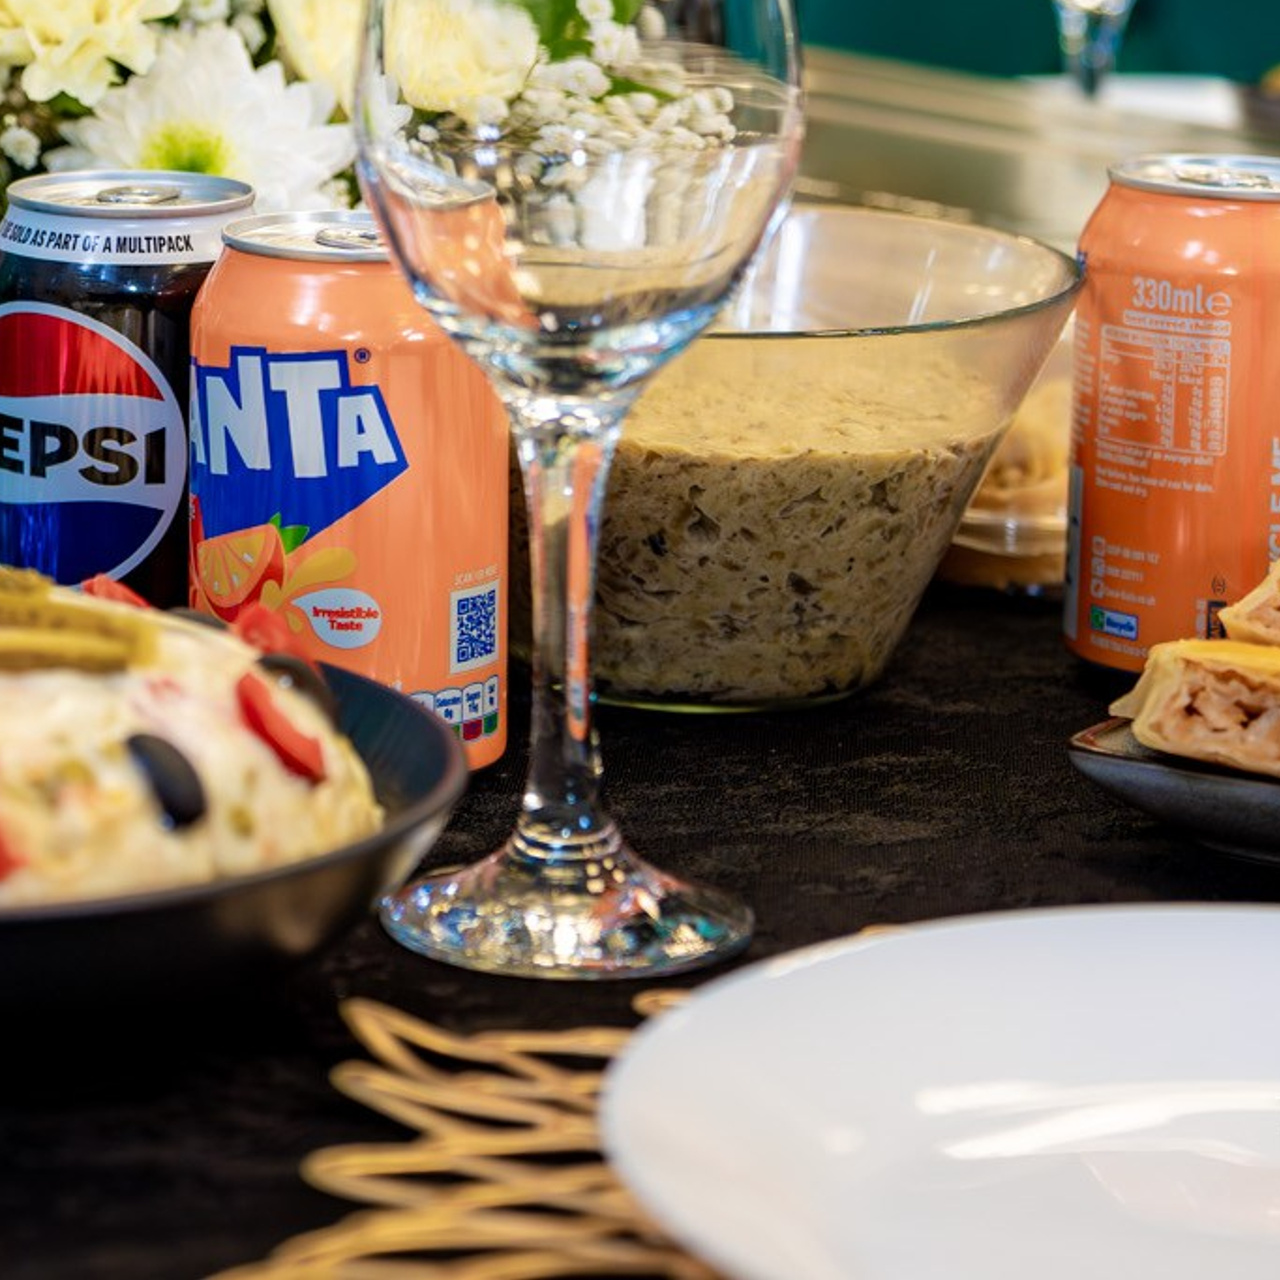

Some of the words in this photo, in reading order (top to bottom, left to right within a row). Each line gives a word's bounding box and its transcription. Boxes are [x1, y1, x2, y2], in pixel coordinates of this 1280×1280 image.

[10, 223, 32, 245] SOLD
[30, 228, 47, 248] AS
[45, 231, 80, 252] PART
[82, 235, 100, 252] OF
[102, 236, 112, 253] A
[116, 234, 194, 254] MULTIPACK
[1131, 274, 1204, 315] 330ml
[312, 605, 379, 619] Irresistible
[327, 619, 363, 631] Taste
